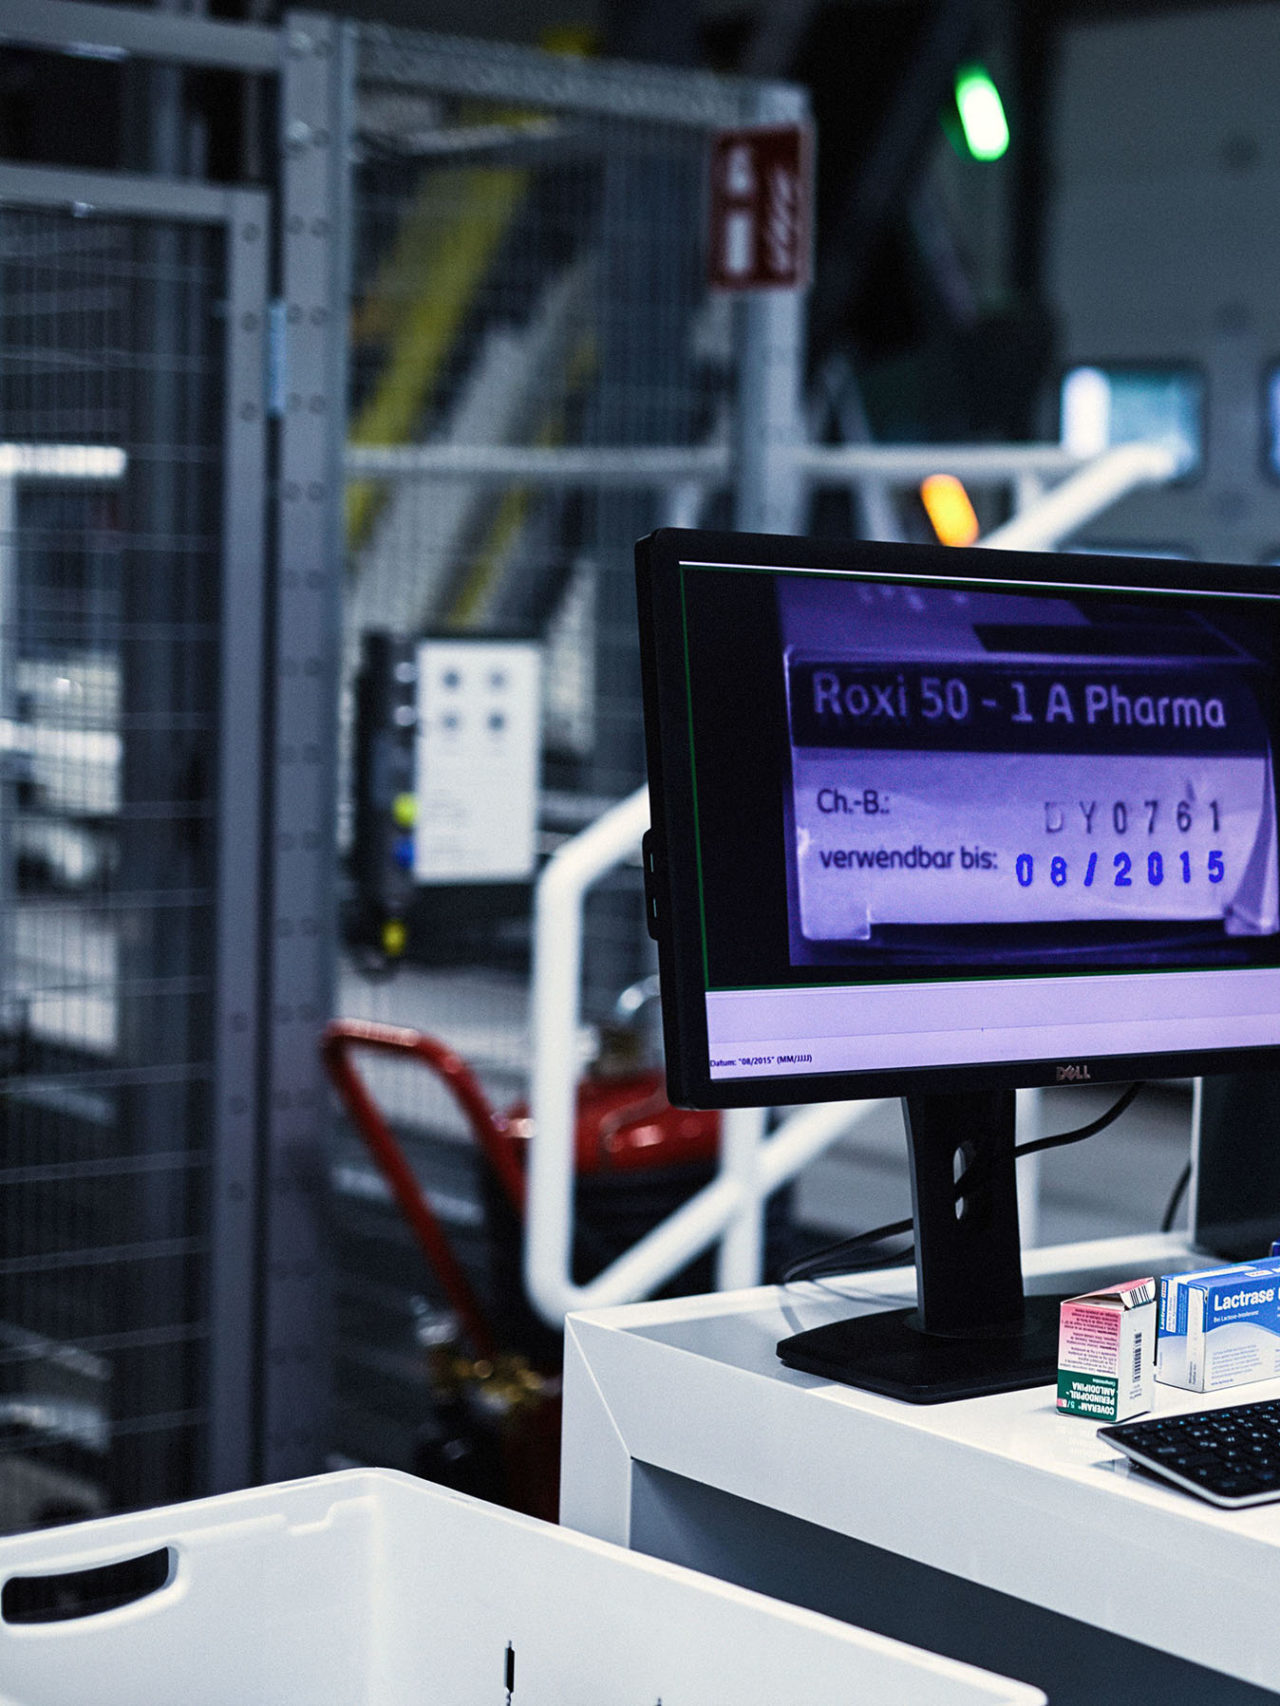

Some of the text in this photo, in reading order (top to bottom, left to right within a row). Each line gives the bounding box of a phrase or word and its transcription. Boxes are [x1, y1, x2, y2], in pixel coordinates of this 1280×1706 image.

[812, 672, 1227, 728] Roxi 50 - 1 A Pharma
[820, 845, 1225, 888] verwendbar bis: 08/2015
[709, 1059, 736, 1068] Datum:
[1056, 1065, 1091, 1080] DELL
[1213, 1289, 1275, 1311] Lactrase
[1072, 1381, 1116, 1396] AMLODIPINA
